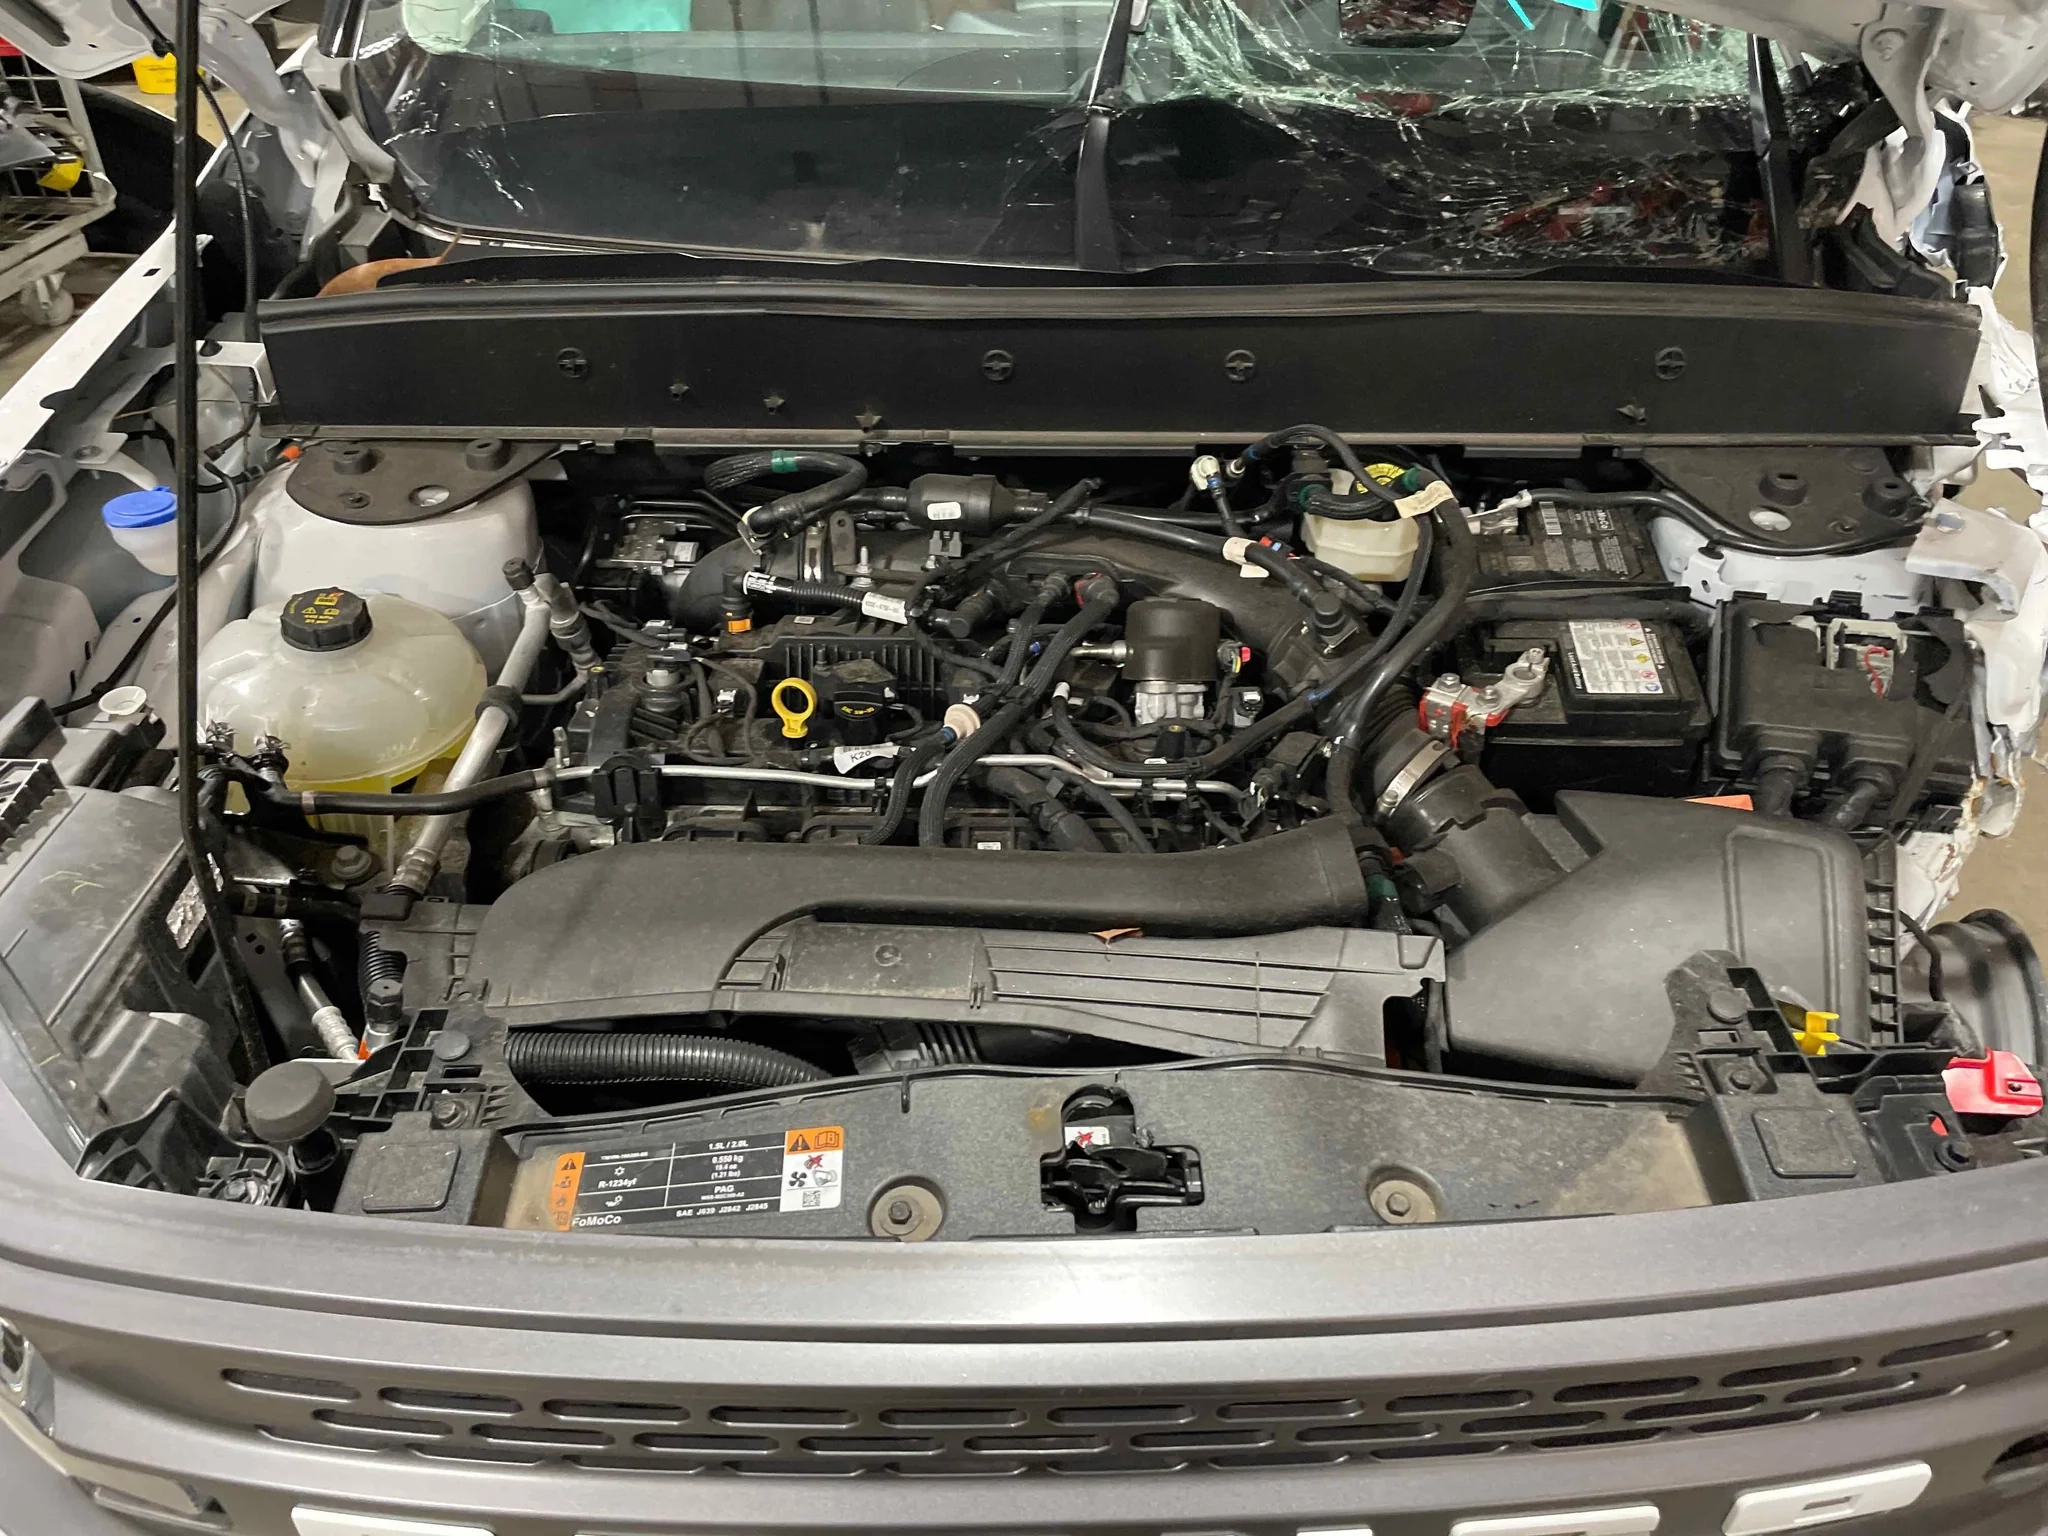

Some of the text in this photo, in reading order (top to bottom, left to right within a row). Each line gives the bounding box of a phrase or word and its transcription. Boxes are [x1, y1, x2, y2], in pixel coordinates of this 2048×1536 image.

[708, 1142, 725, 1150] 1.5L
[731, 1140, 749, 1148] 2.0L
[711, 1154, 744, 1164] 0.550 kg
[598, 1178, 637, 1189] R-1234yf
[714, 1185, 735, 1194] PAG
[676, 1203, 769, 1218] SAE J639 J2842 J2845
[572, 1214, 622, 1227] FoMoCo
